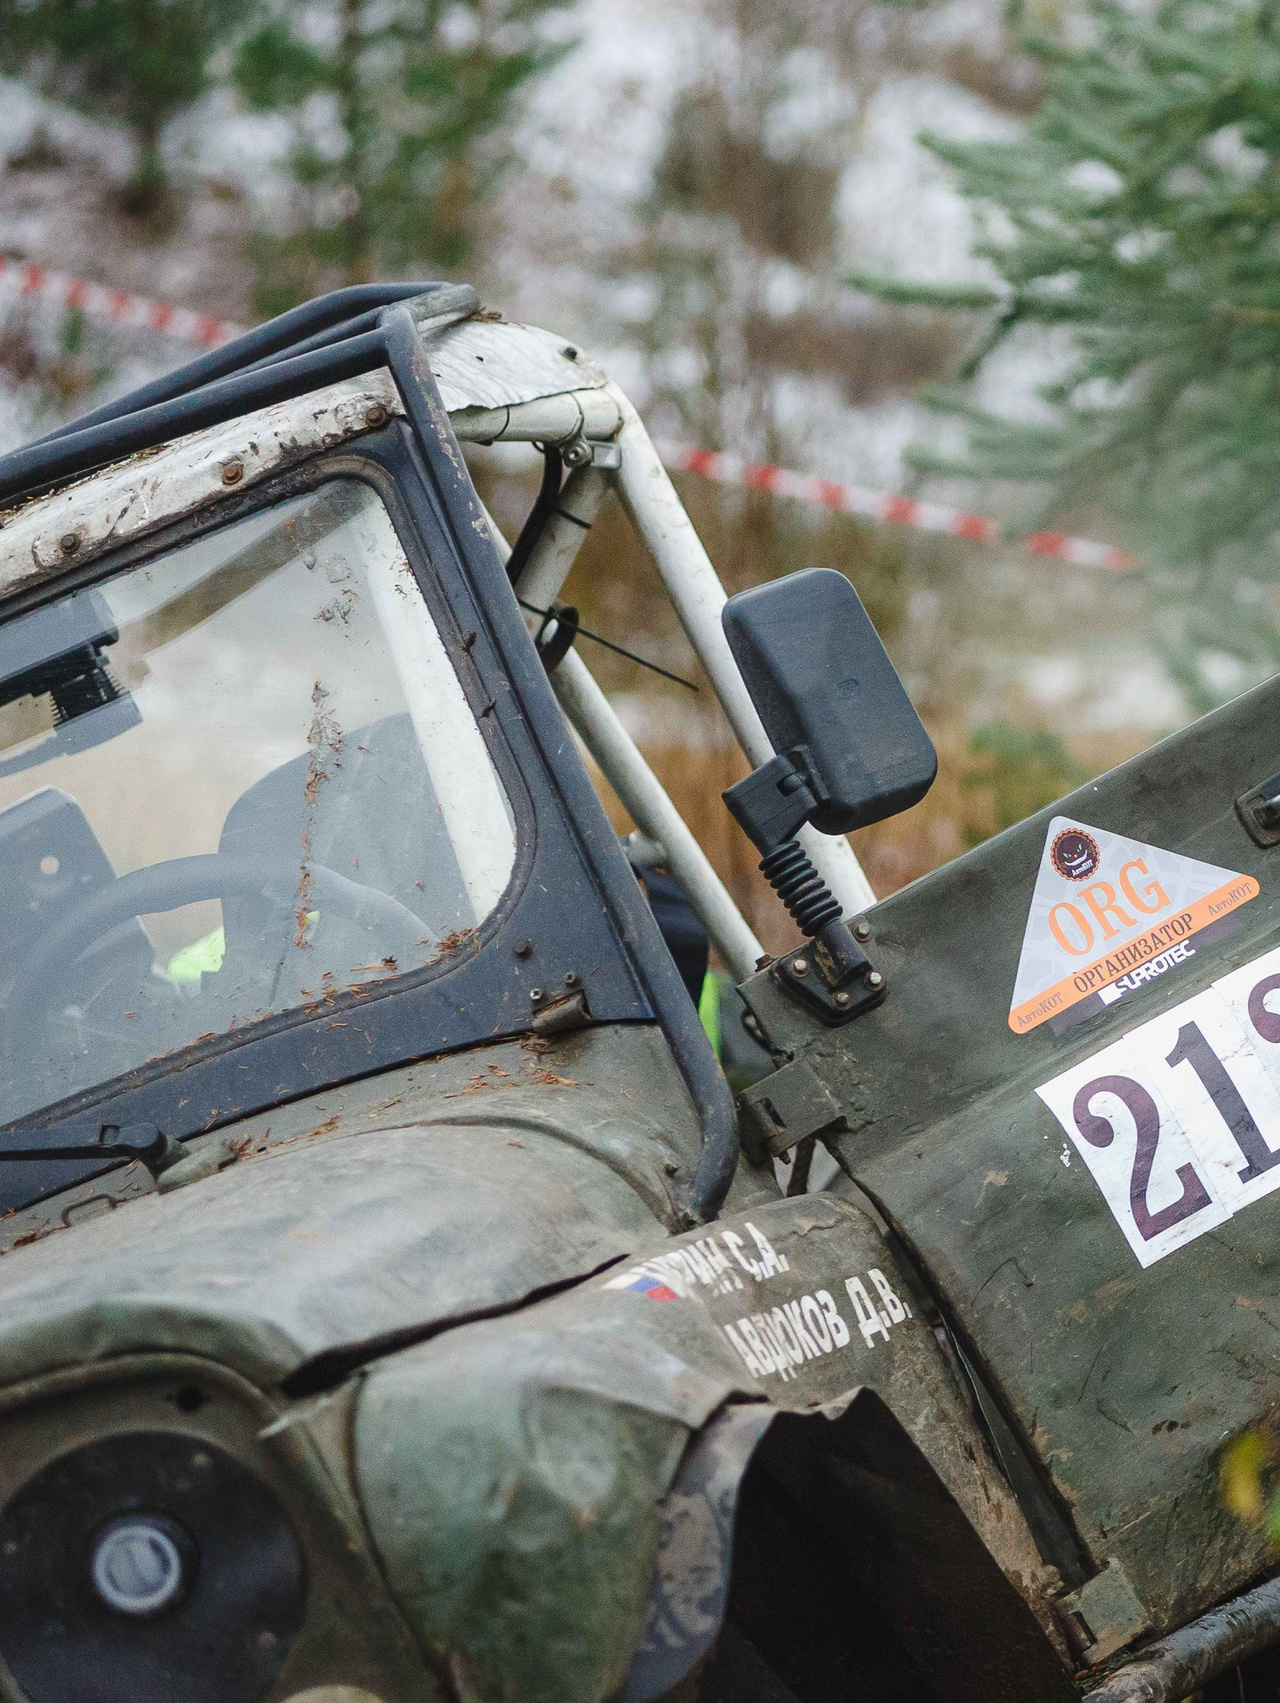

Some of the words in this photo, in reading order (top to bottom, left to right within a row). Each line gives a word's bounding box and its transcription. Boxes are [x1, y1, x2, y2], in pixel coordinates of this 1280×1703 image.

[1048, 856, 1170, 956] ORG
[1073, 912, 1194, 993] ОРГАНИЗАТОР
[1110, 940, 1196, 997] SUPROTEC
[845, 1268, 913, 1349] Д.В.
